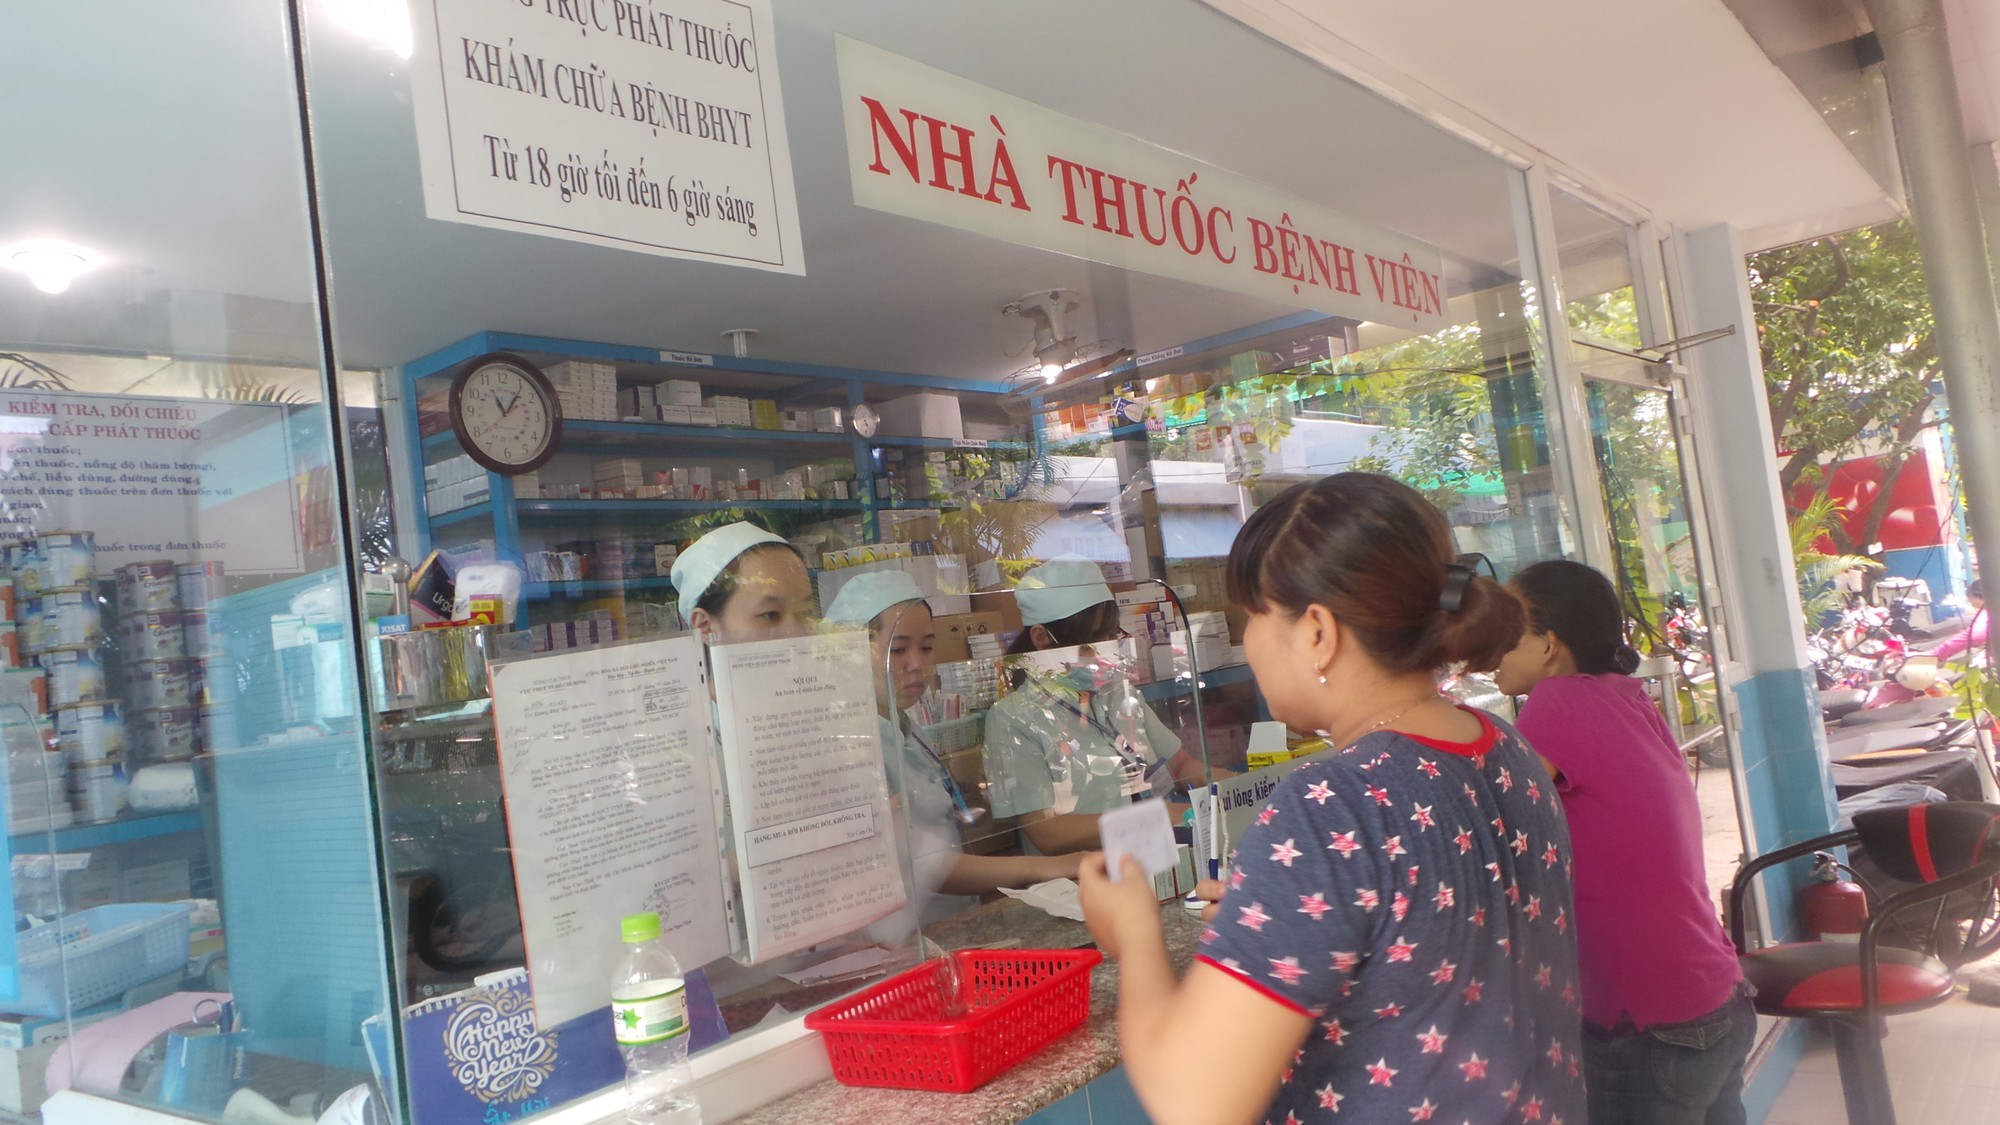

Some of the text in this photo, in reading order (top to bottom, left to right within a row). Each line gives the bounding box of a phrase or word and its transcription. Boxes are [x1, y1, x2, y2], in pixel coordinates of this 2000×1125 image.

[679, 22, 754, 73] THUỐC
[460, 37, 752, 148] KHÁM CHỮA BỆNH BHYT
[483, 134, 758, 237] Từ 18 giờ tối đến 6 giờ sáng
[860, 95, 1443, 323] NHÀ THUỐC BỆNH VIỆN
[480, 374, 490, 386] 11
[497, 371, 508, 385] 12
[469, 388, 480, 400] 10
[528, 392, 535, 404] 2
[8, 396, 197, 420] KIỂM TRA, ĐỐI CHIẾU
[467, 405, 475, 417] 9
[534, 411, 541, 423] 3
[49, 420, 201, 440] CẤP PHÁT THUỐC
[473, 425, 481, 438] 8
[530, 431, 538, 442] 4
[485, 441, 493, 452] 7
[504, 447, 512, 459] 6
[521, 443, 529, 456] 5
[1233, 787, 1253, 807] lòng
[449, 1004, 537, 1056] Happy
[463, 1036, 530, 1061] New
[459, 1050, 535, 1091] Year
